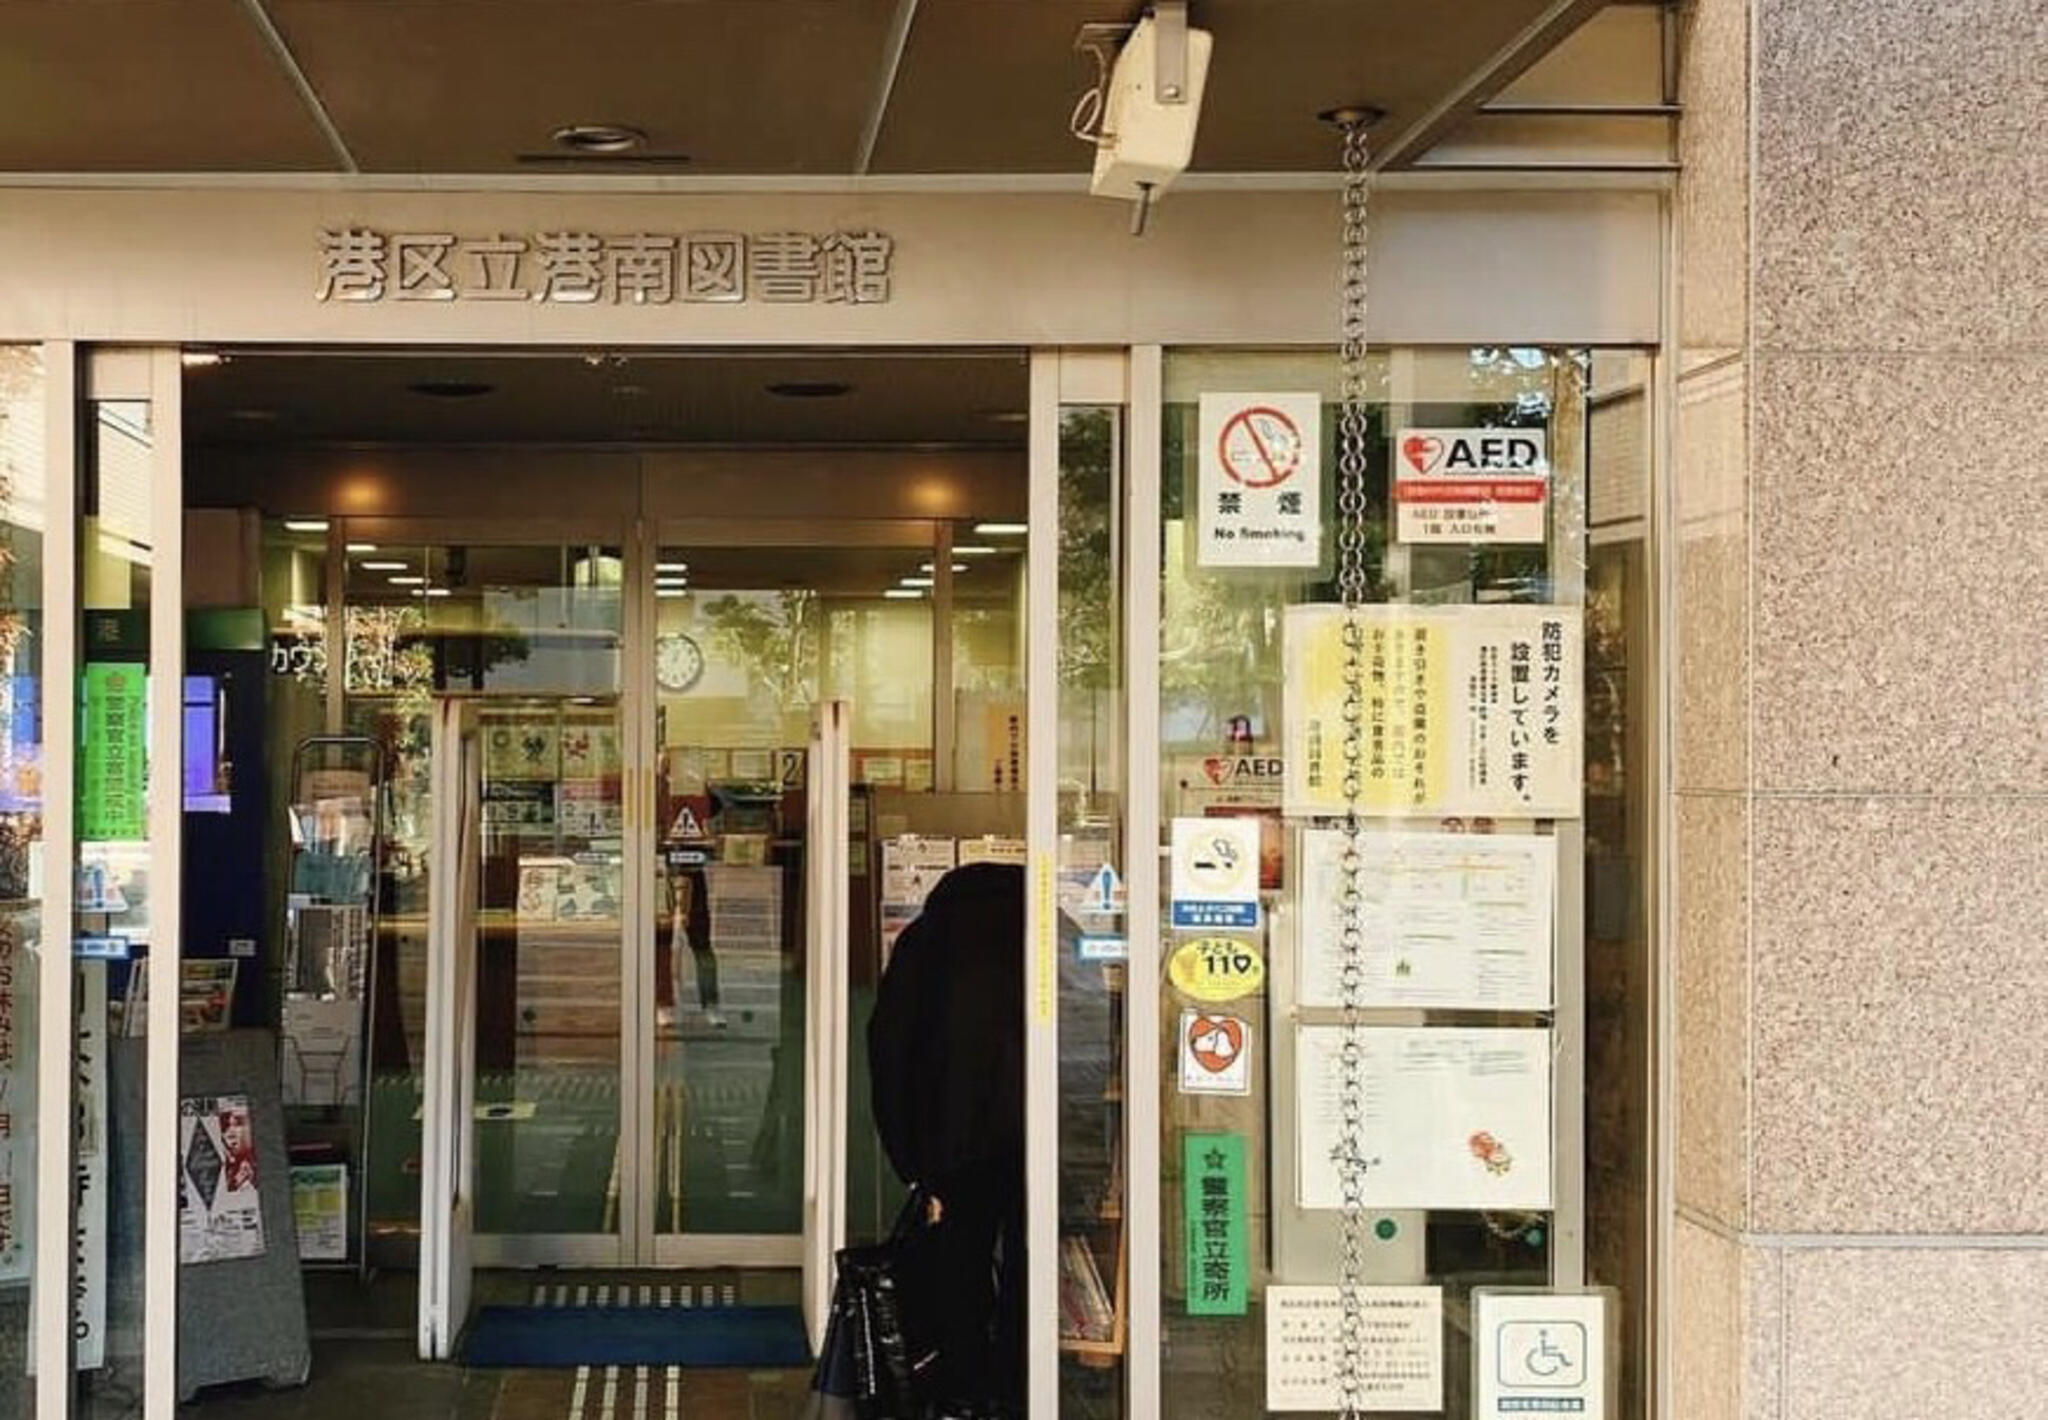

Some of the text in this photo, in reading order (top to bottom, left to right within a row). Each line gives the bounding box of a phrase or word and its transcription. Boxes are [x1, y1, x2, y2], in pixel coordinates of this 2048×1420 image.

[316, 229, 893, 304] 港区立港南図書館
[1446, 438, 1537, 468] AED
[1214, 525, 1304, 541] No Smoking
[1542, 621, 1562, 745] 防犯カメラを
[1510, 642, 1532, 801] 設置しています。
[1235, 758, 1283, 776] AED
[1203, 1177, 1230, 1301] 警察官立寄所
